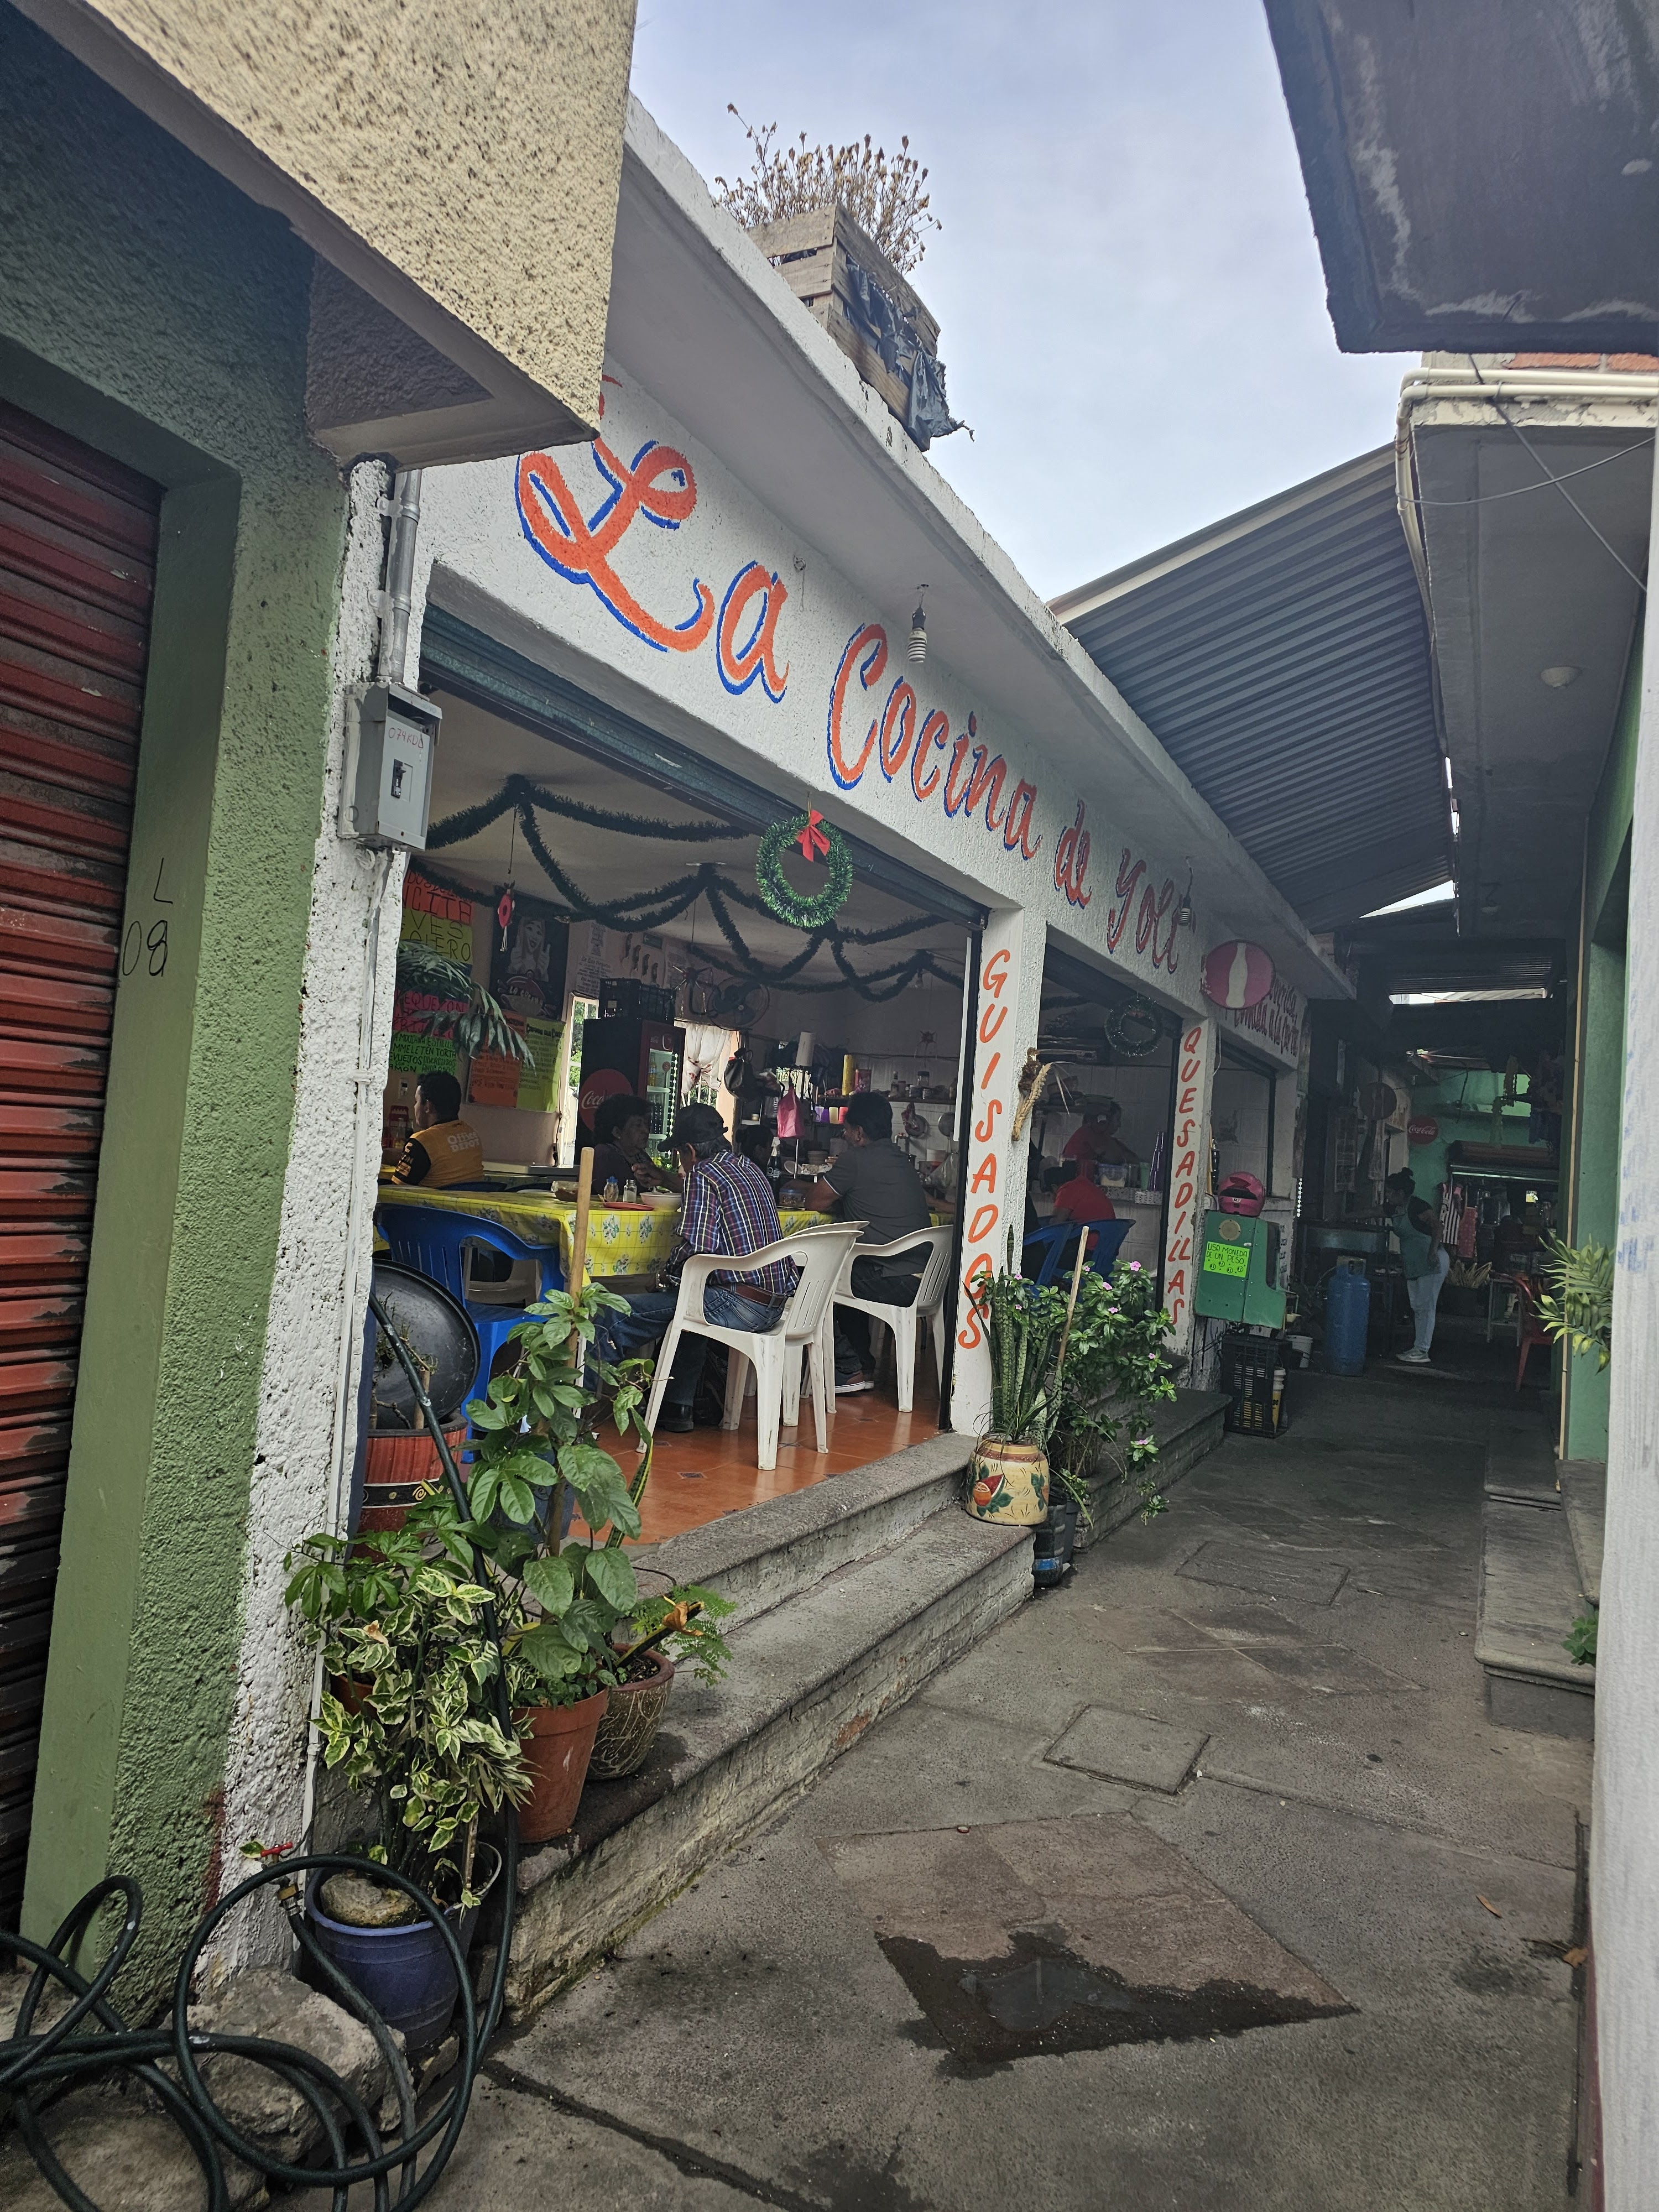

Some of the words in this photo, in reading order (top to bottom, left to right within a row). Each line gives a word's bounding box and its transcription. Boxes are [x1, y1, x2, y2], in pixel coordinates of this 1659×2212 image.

[515, 375, 790, 703] La
[827, 623, 1042, 861] Cocina
[1053, 797, 1092, 910] de
[958, 948, 1011, 1350] GUISADOS
[1168, 1026, 1202, 1326] QUESADILLAS
[1206, 1250, 1213, 1259] DE
[1227, 1254, 1244, 1265] PESO
[1208, 1243, 1220, 1252] USA
[1222, 1247, 1248, 1258] MONEDA
